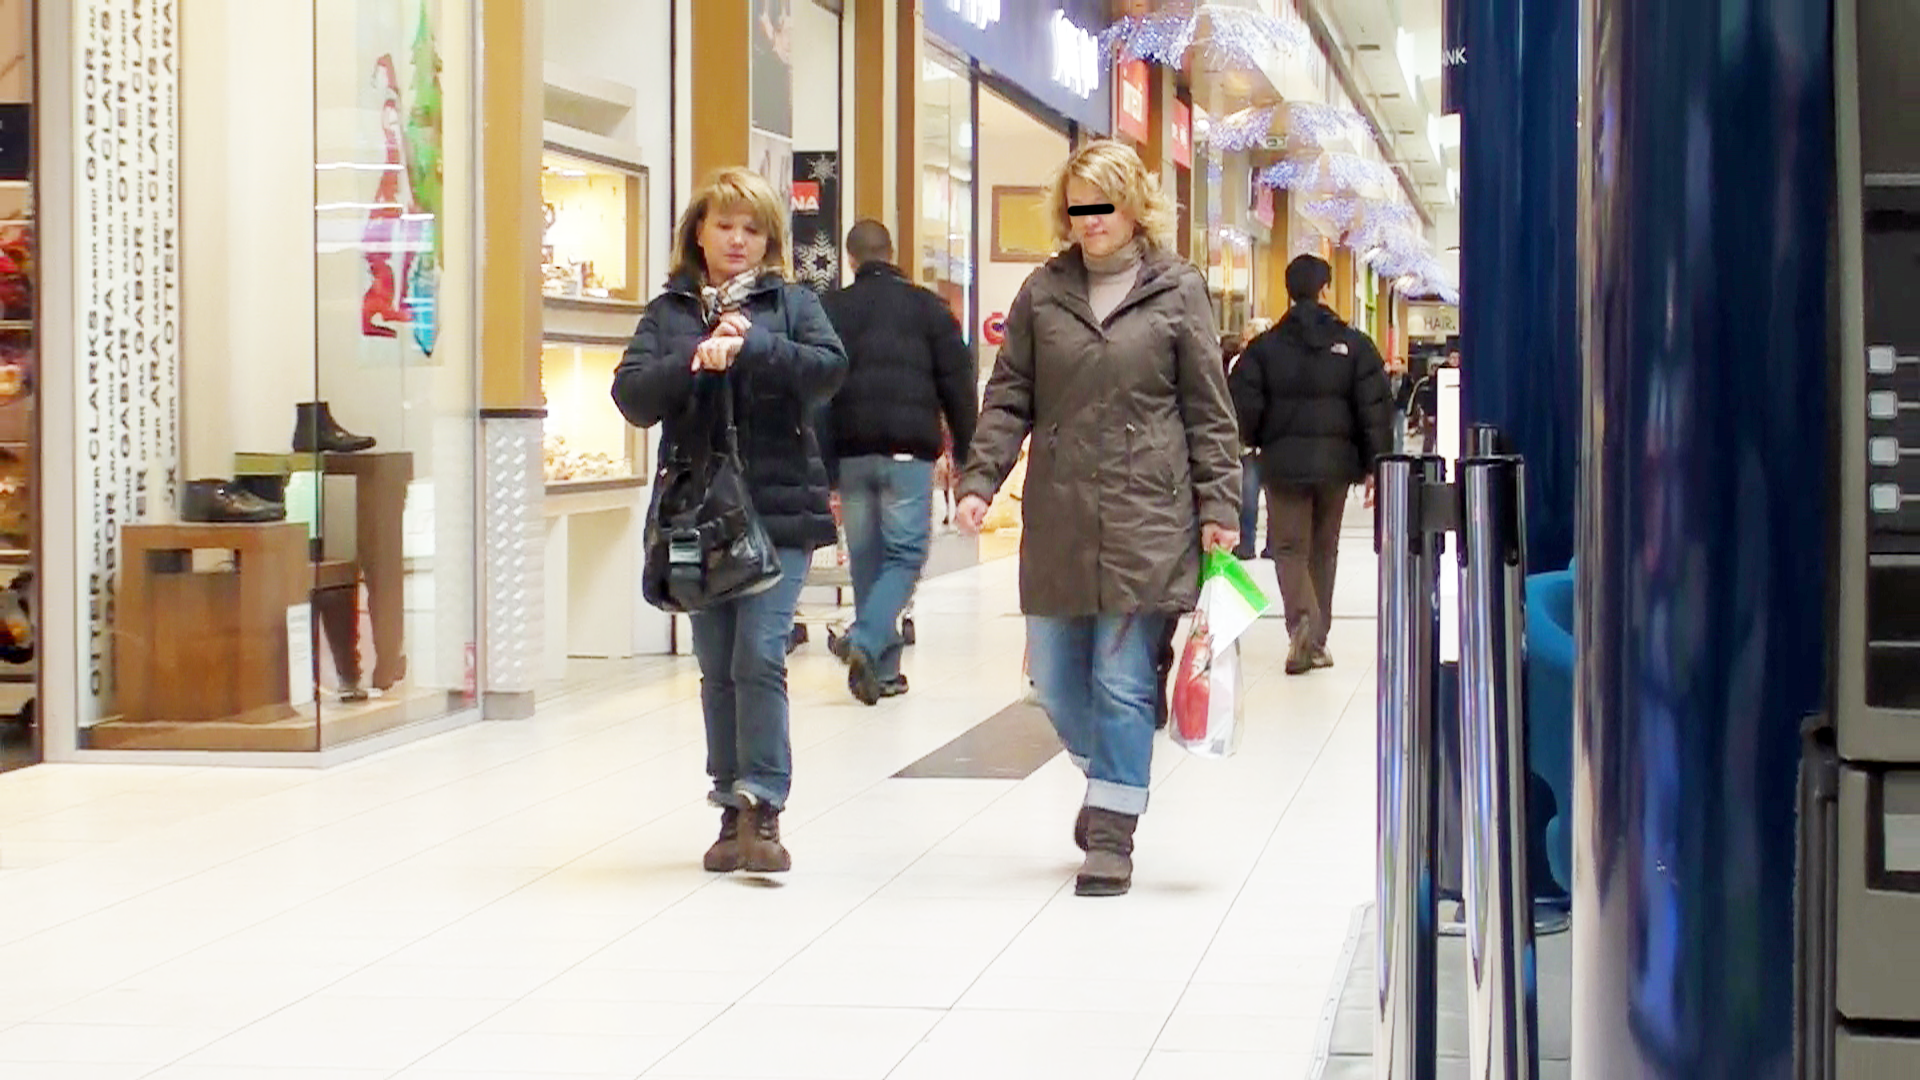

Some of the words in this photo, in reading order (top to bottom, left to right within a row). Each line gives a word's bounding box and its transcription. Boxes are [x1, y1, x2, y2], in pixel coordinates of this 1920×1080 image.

[101, 11, 113, 162] CLARKS
[131, 0, 143, 97] CLAR
[161, 2, 173, 76] ARA
[85, 48, 97, 183] GABOR
[116, 81, 128, 205] OTTER
[147, 57, 159, 204] CLARKS
[103, 289, 114, 364] ARA
[134, 228, 145, 357] GABOR
[163, 228, 175, 346] OTTER
[88, 311, 100, 462] CLARKS
[119, 329, 131, 460] GABOR
[149, 336, 161, 410] ARA
[89, 574, 102, 697] OTTER
